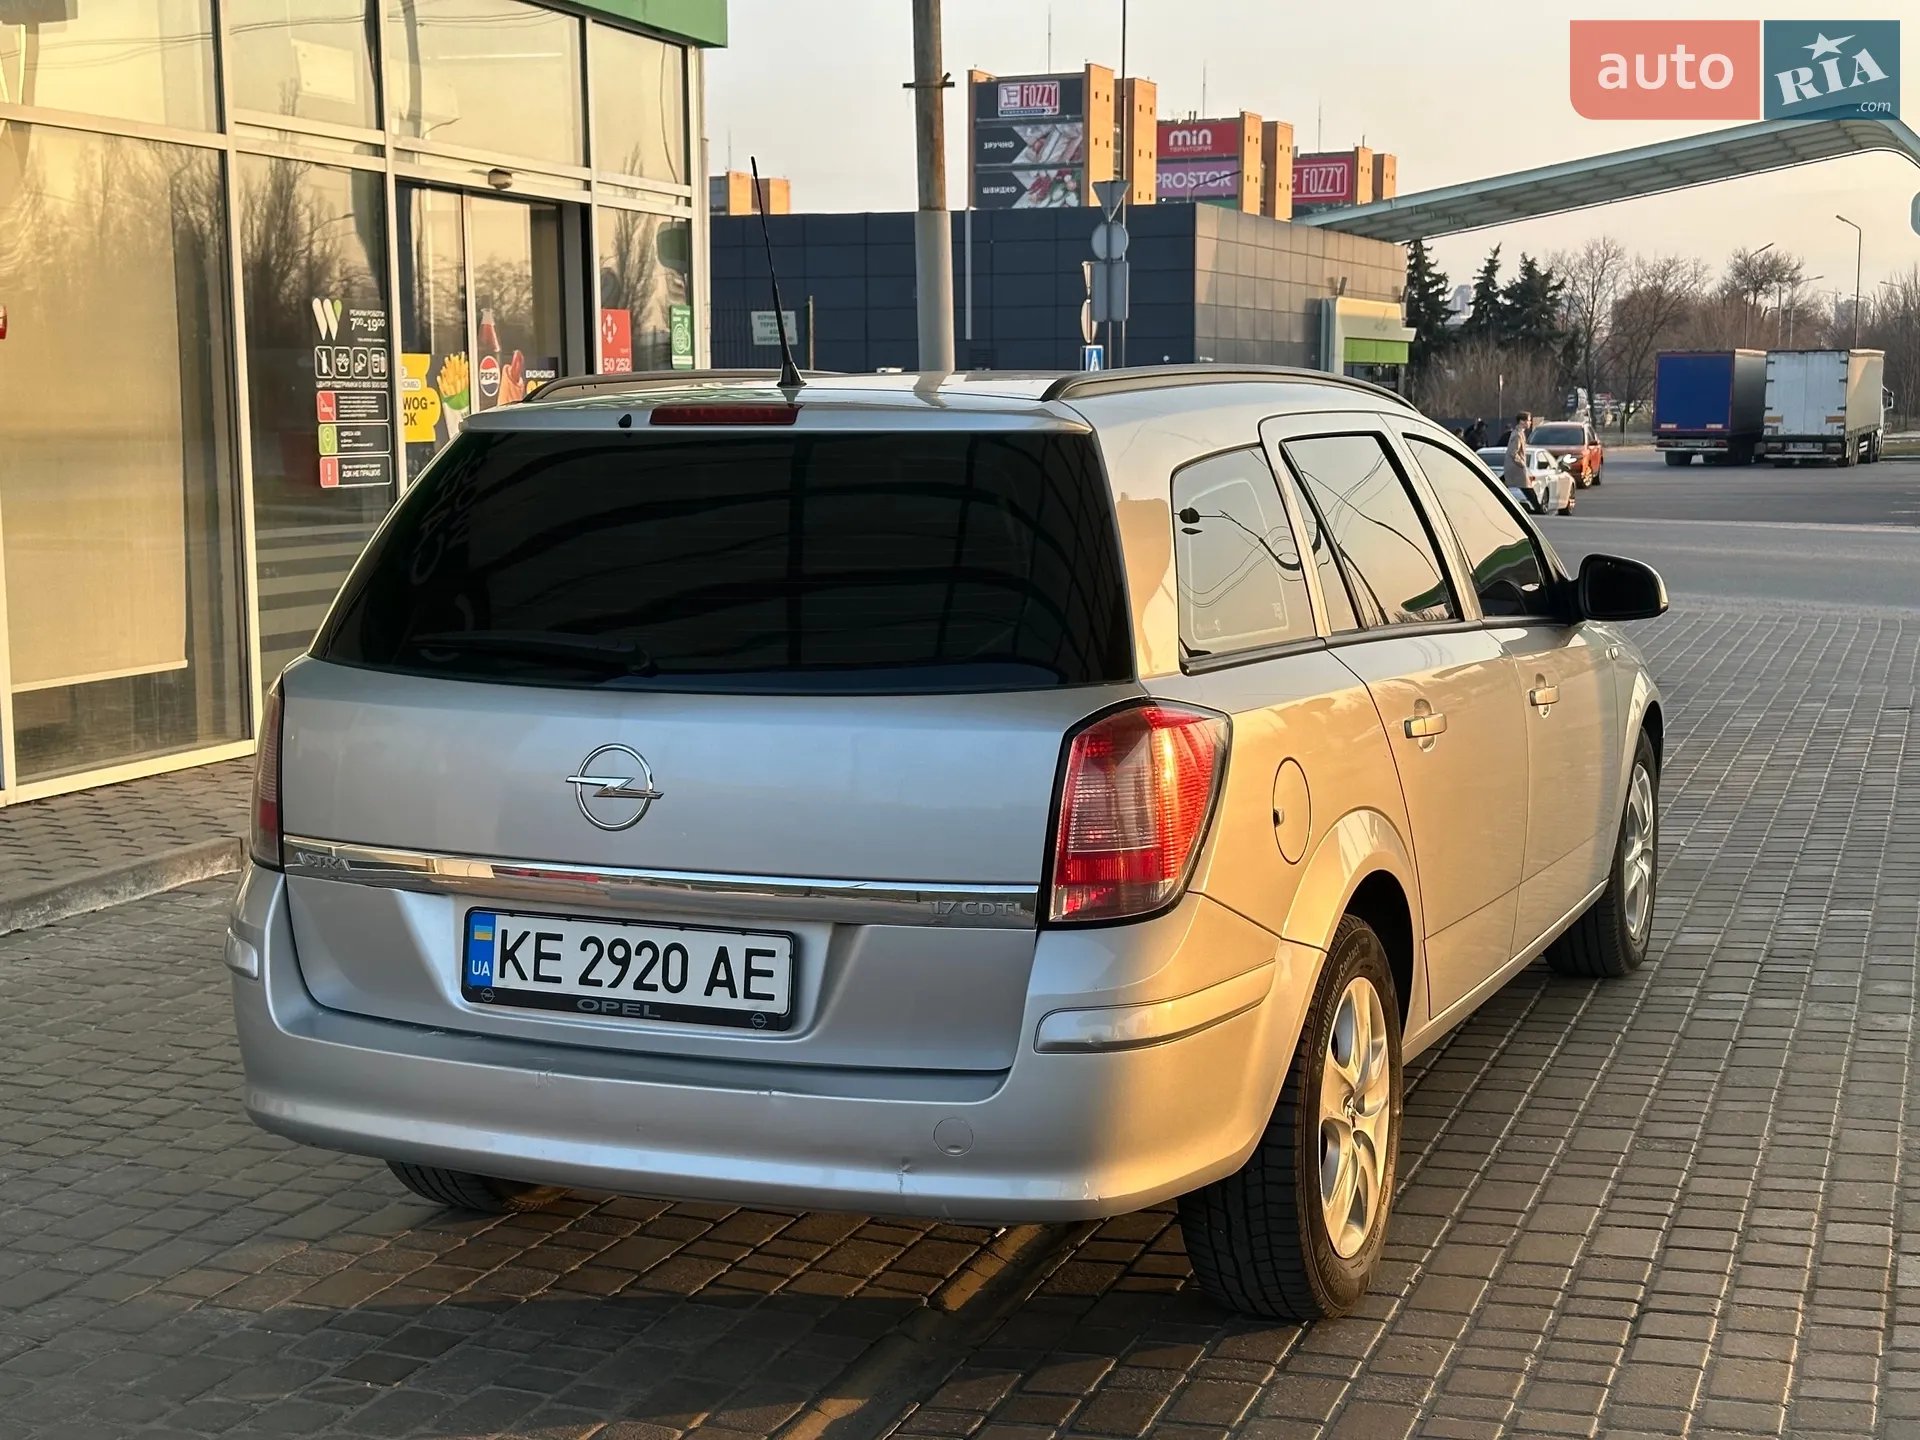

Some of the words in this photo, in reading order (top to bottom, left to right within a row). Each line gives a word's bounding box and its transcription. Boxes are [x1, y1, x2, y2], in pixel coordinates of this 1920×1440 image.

[1023, 84, 1057, 107] FOZZY
[1169, 129, 1212, 146] min
[1156, 171, 1232, 188] PROSTOR
[1302, 166, 1343, 193] FOZZY
[293, 852, 350, 871] ASTRA
[961, 902, 1021, 916] CDTI
[472, 960, 490, 977] UA
[499, 929, 563, 983] KE
[578, 936, 689, 994] 2920
[703, 946, 776, 1001] AE
[576, 999, 661, 1018] OPEL
